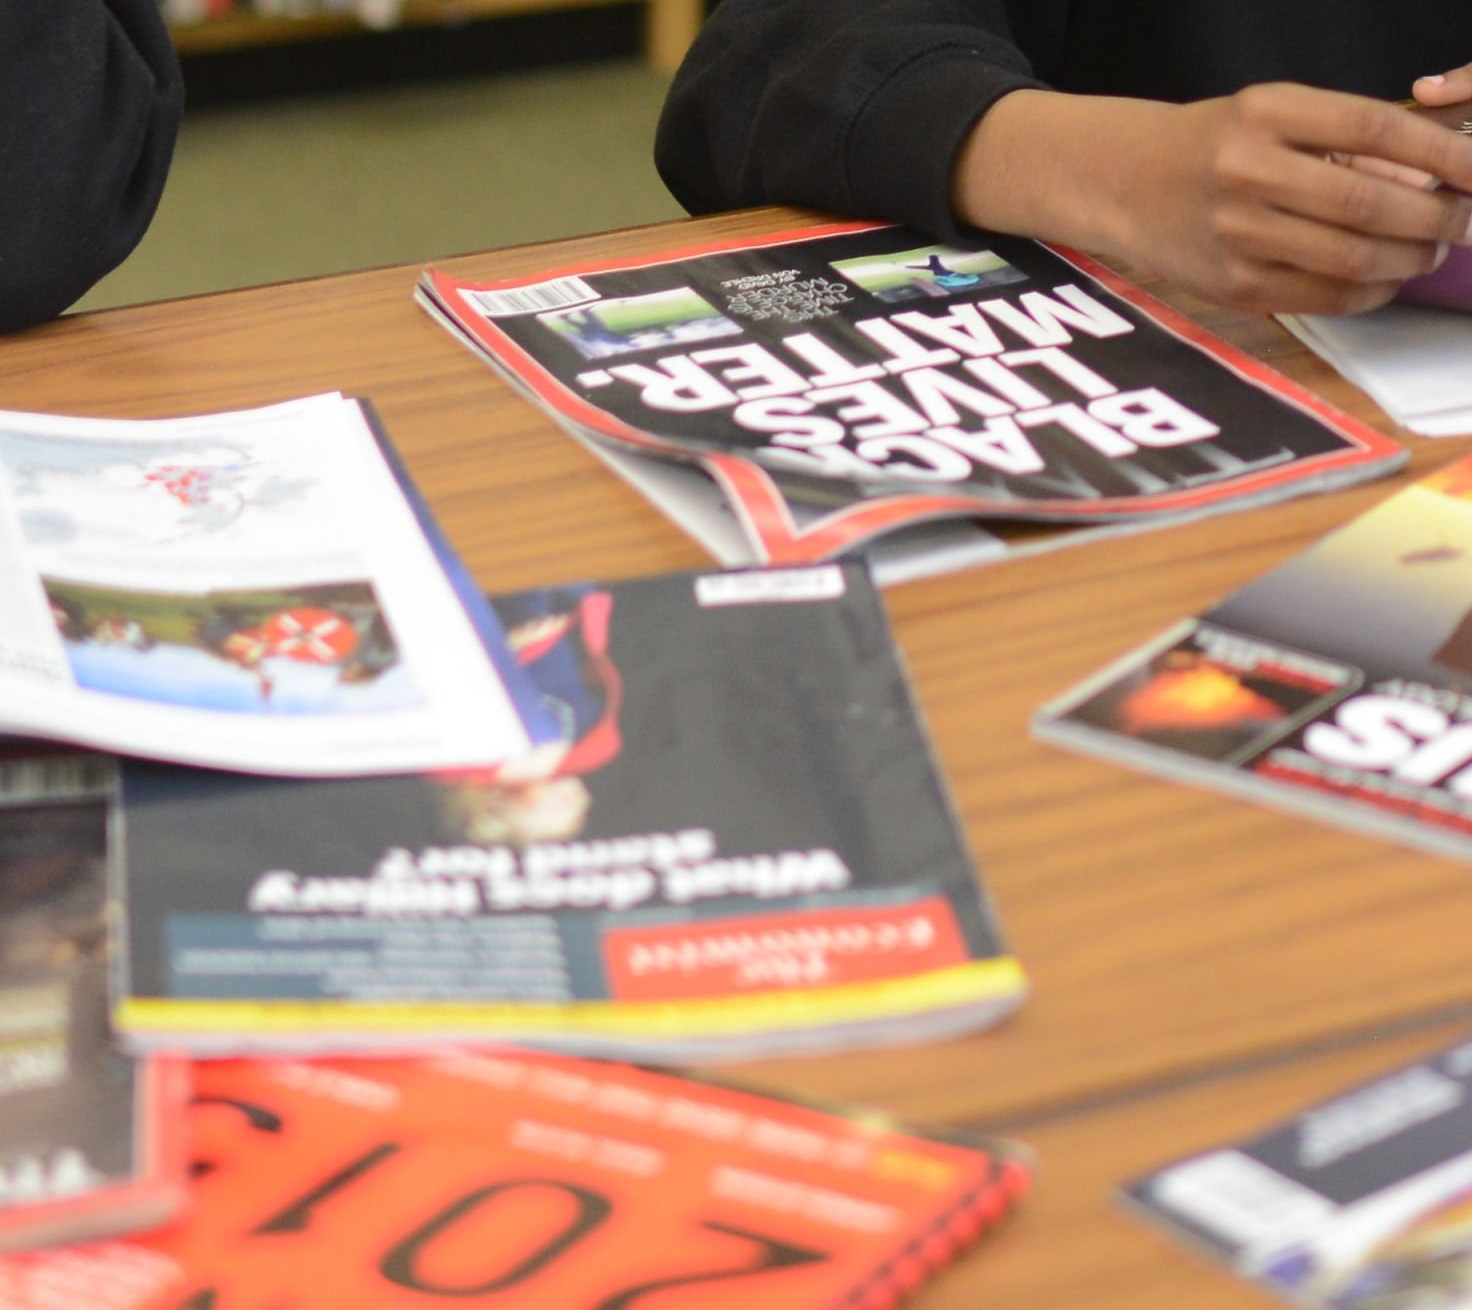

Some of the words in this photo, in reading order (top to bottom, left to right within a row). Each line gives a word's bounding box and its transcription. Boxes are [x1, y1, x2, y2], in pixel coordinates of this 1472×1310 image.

[576, 283, 1138, 412] MATTER.
[733, 344, 1118, 450] LIVES
[733, 387, 1222, 482] BLACK
[523, 828, 717, 867] stand
[664, 847, 853, 899] What
[485, 865, 657, 912] does
